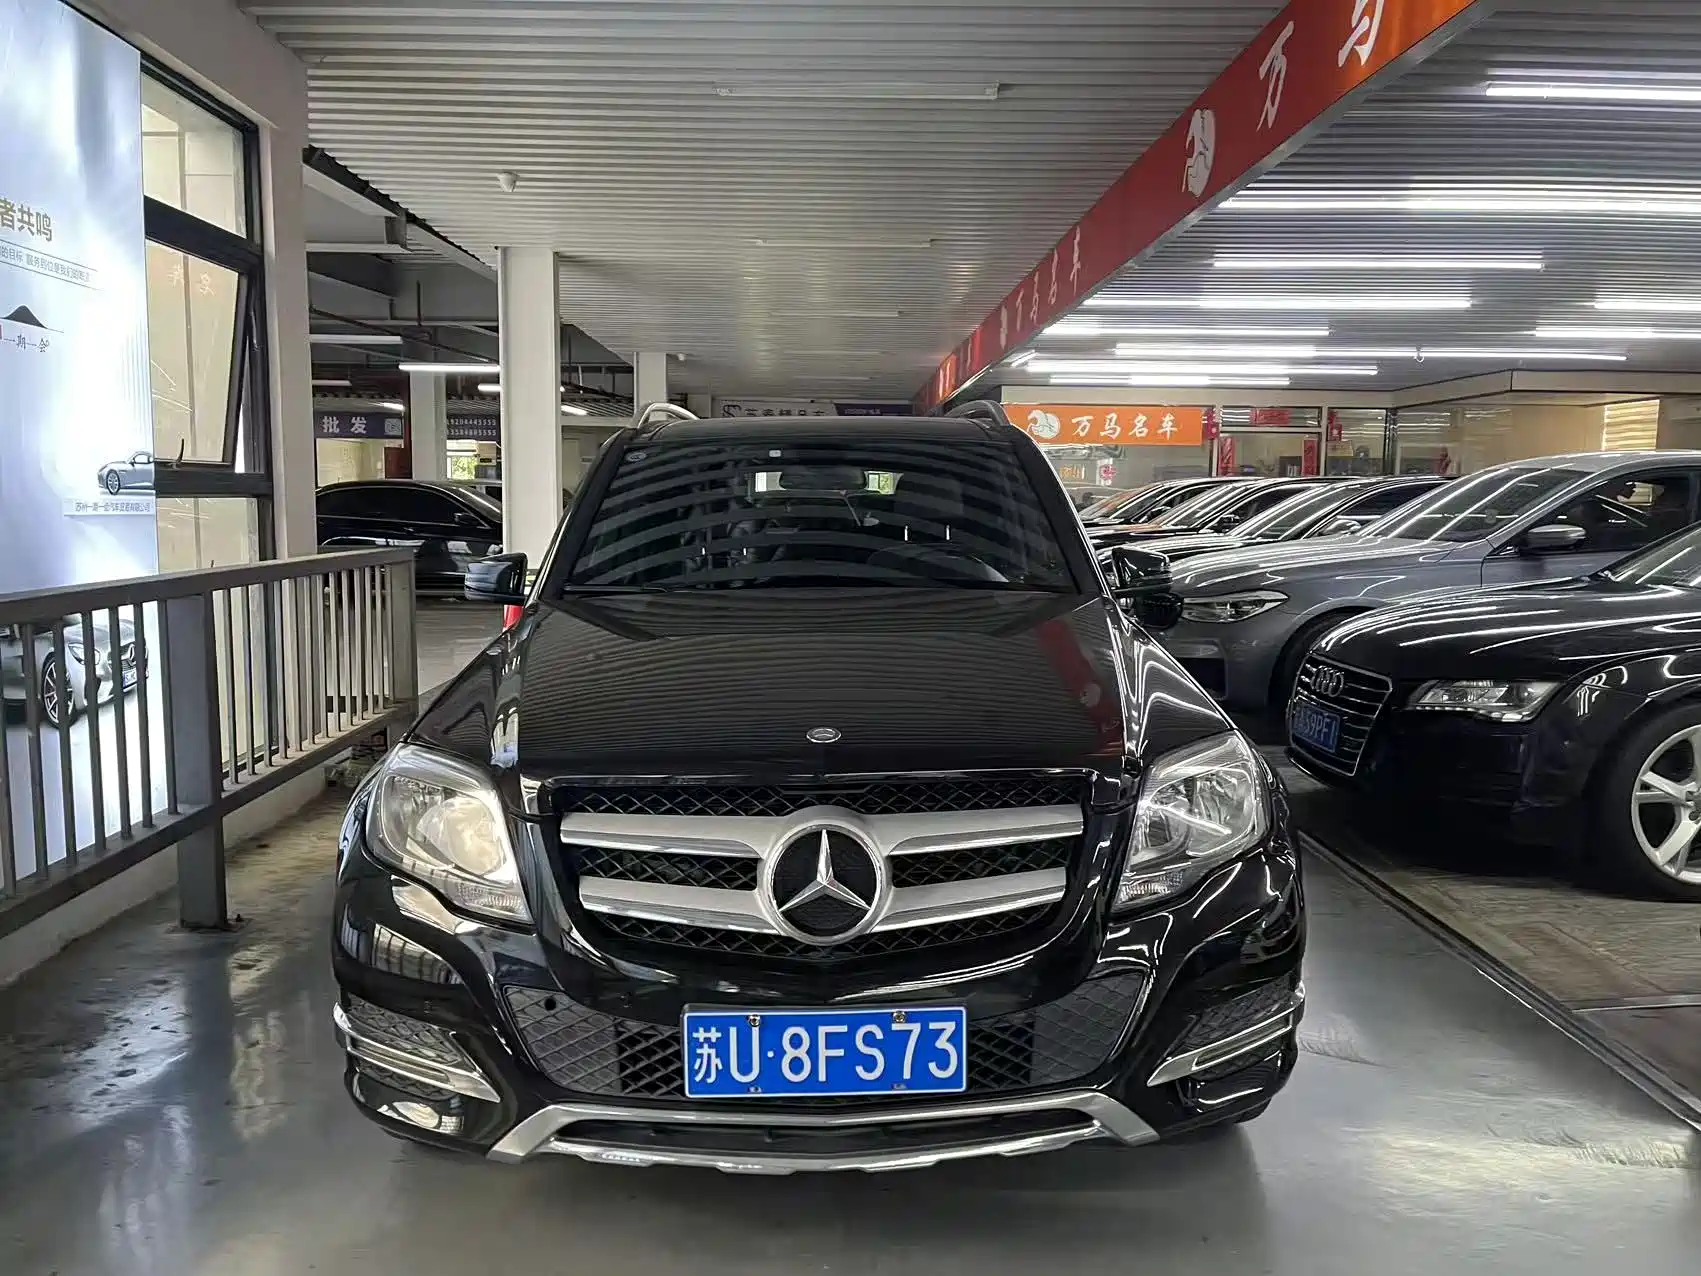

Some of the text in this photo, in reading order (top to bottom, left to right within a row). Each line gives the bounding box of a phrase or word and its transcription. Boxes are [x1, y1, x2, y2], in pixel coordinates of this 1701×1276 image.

[0, 197, 53, 242] 者共鸣
[322, 416, 367, 434] 批发
[1071, 412, 1178, 440] 万马名车
